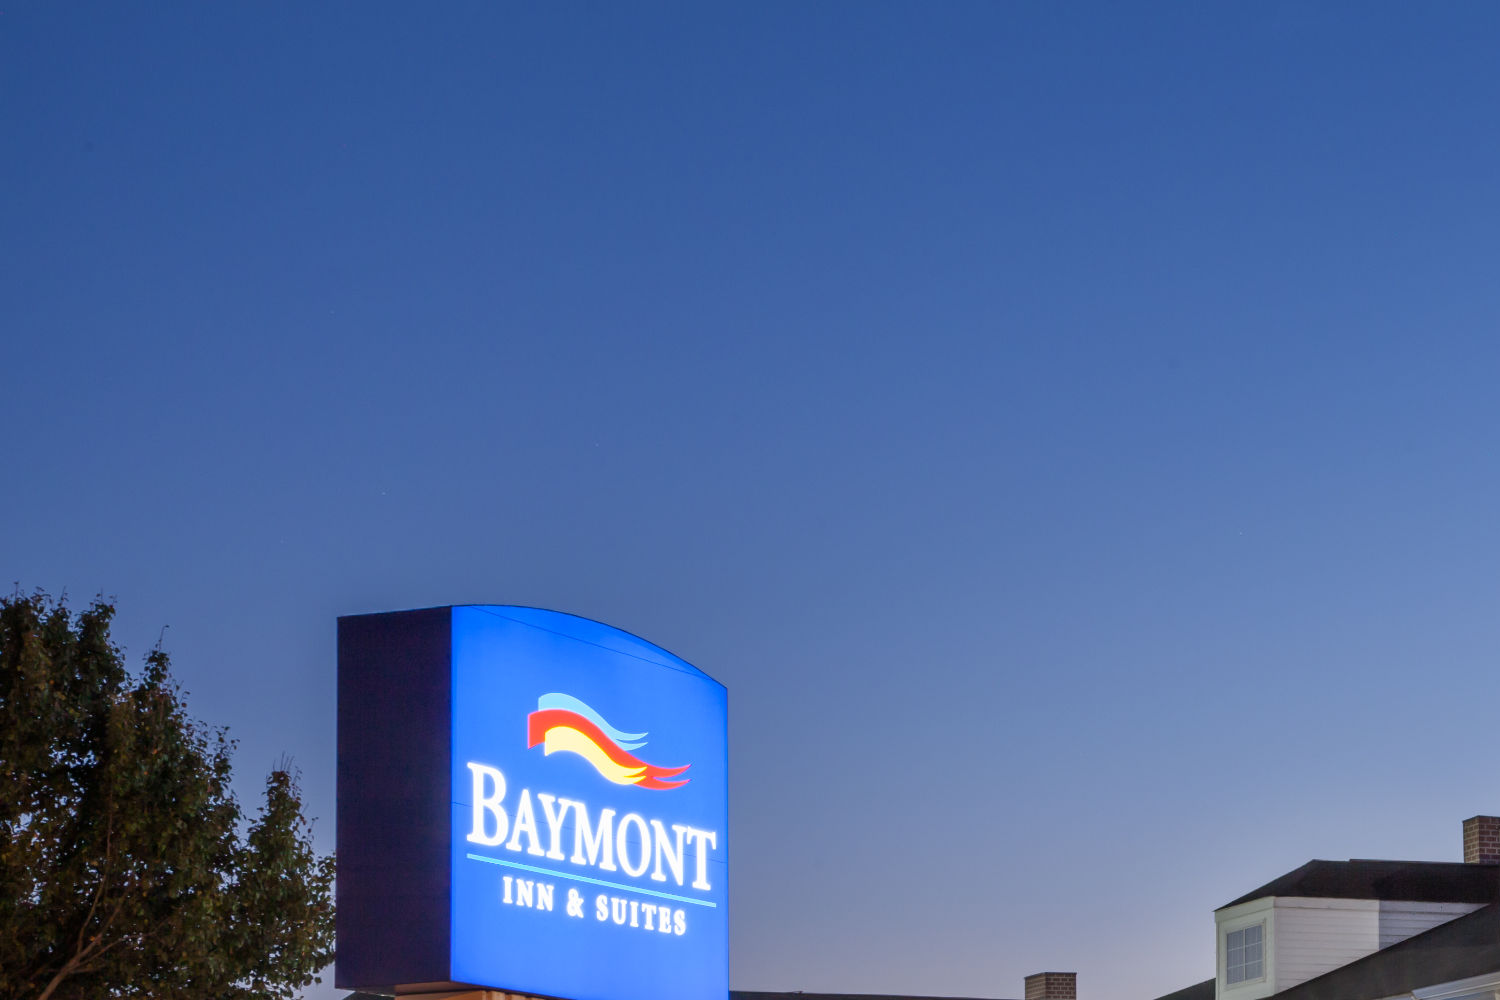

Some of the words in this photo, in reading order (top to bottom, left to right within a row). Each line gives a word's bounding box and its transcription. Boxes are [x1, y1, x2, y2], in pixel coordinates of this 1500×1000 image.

[466, 761, 717, 891] BAYMONT
[502, 875, 554, 911] INN
[566, 888, 584, 918] &
[596, 894, 687, 936] SUITES
